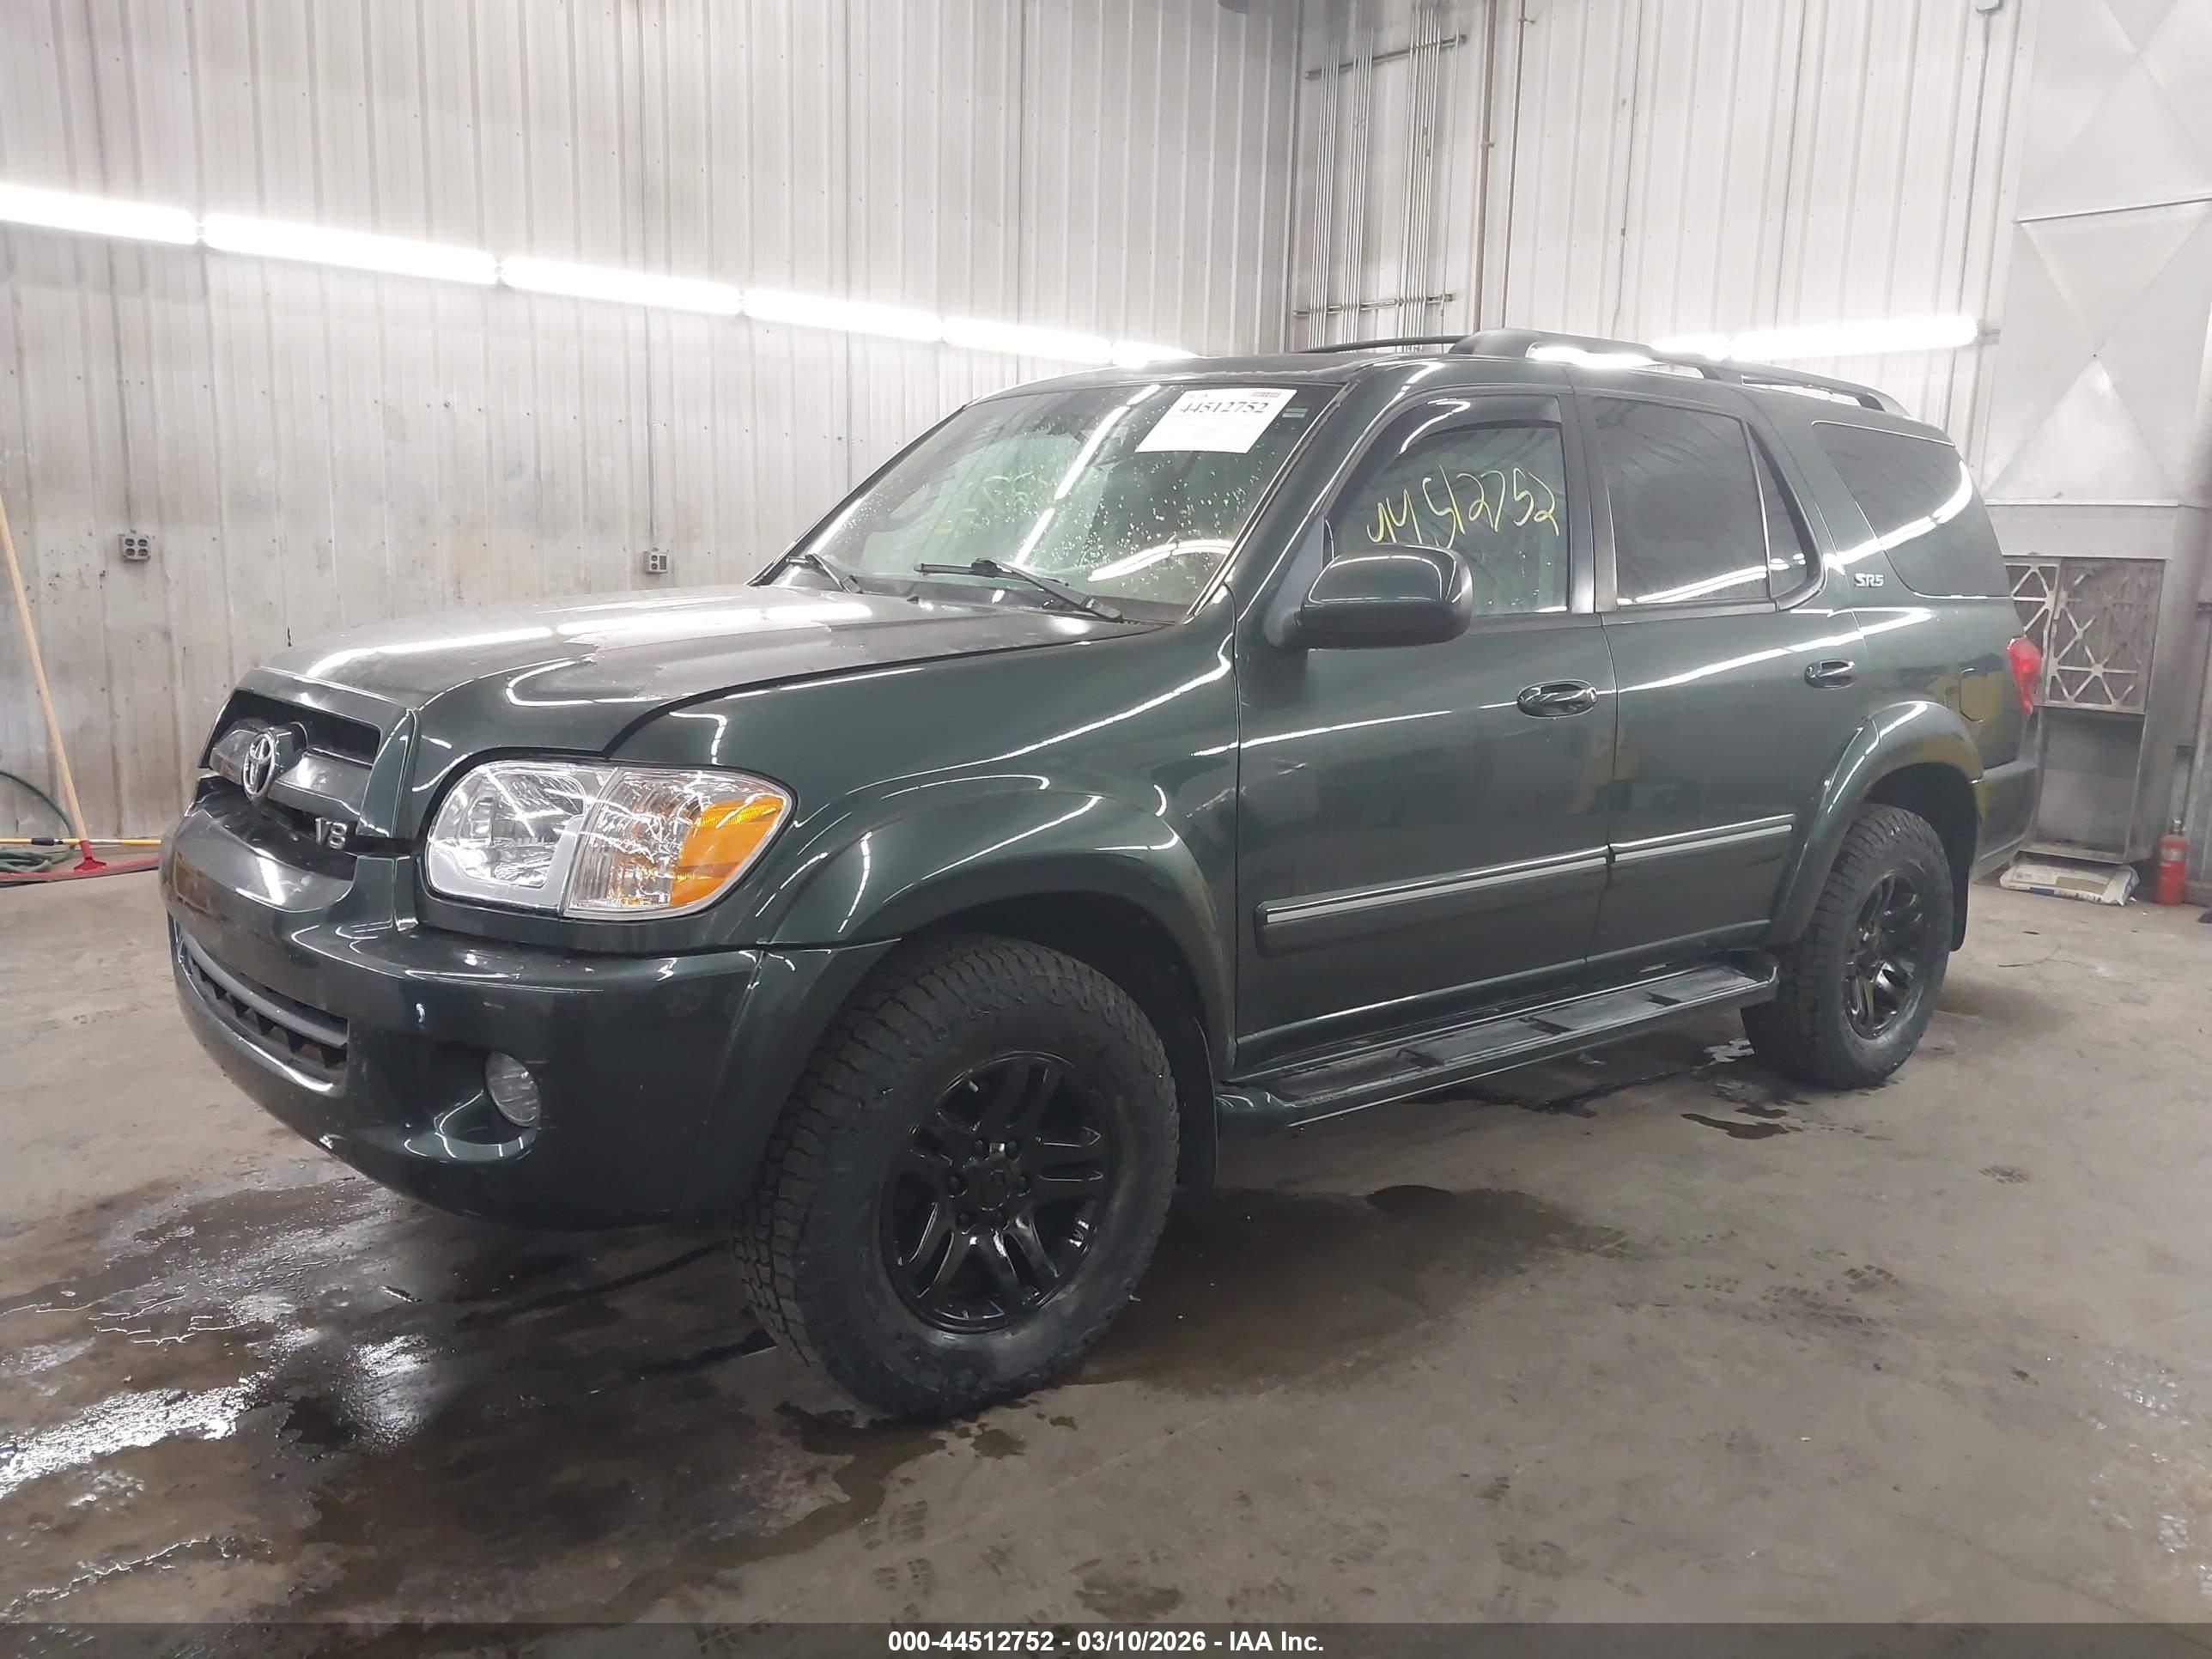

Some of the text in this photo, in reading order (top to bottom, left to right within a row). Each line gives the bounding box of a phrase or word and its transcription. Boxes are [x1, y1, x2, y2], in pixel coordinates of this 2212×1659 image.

[1179, 400, 1269, 414] 44512752
[1854, 573, 1885, 587] SR5
[314, 817, 348, 849] V8
